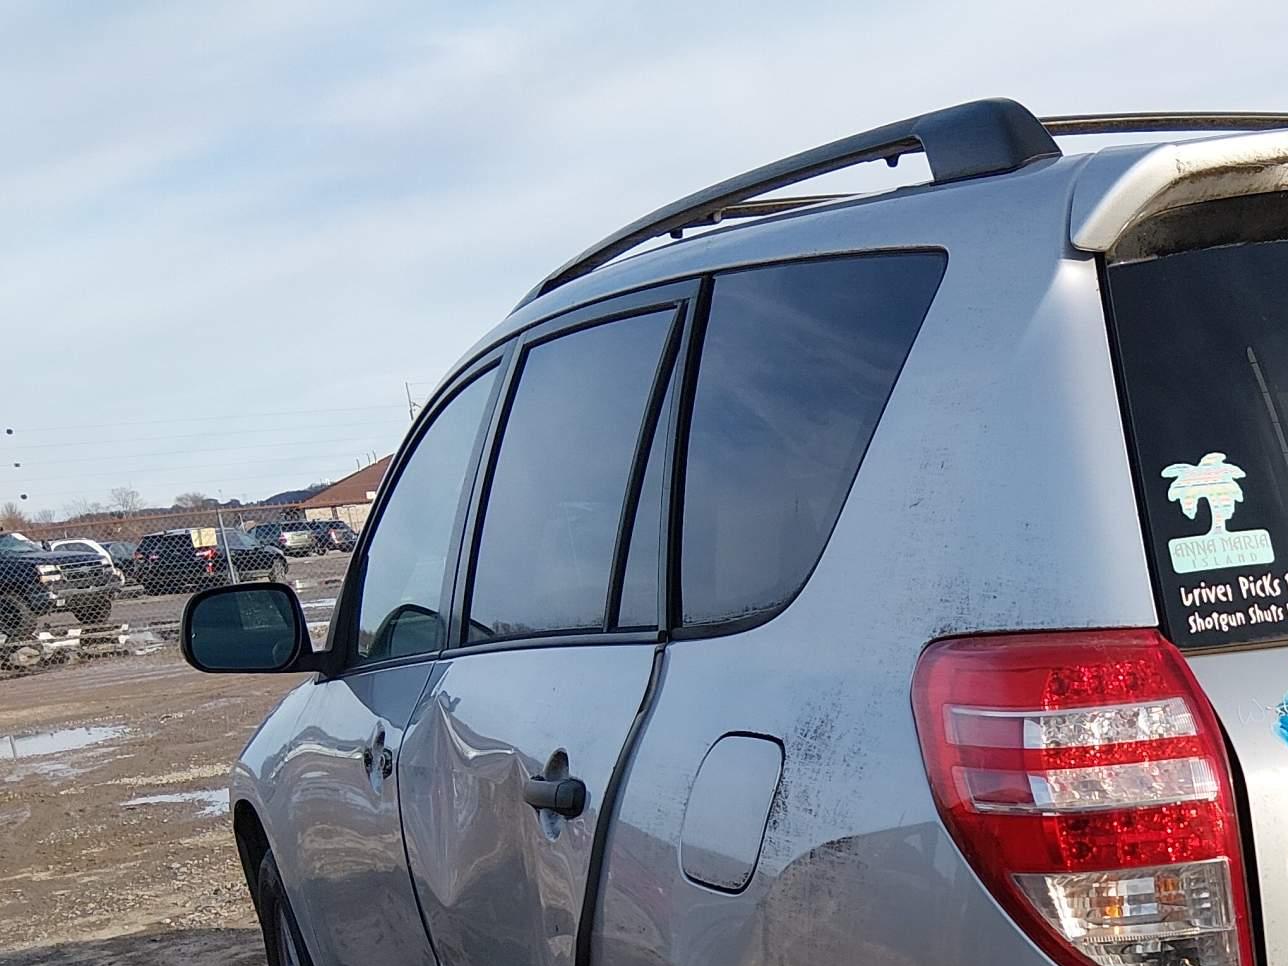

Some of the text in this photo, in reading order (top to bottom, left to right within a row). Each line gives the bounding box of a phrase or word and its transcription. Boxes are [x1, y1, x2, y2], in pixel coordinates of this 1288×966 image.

[1174, 533, 1270, 558] ANNA MARIA
[1191, 552, 1258, 569] ISLAND
